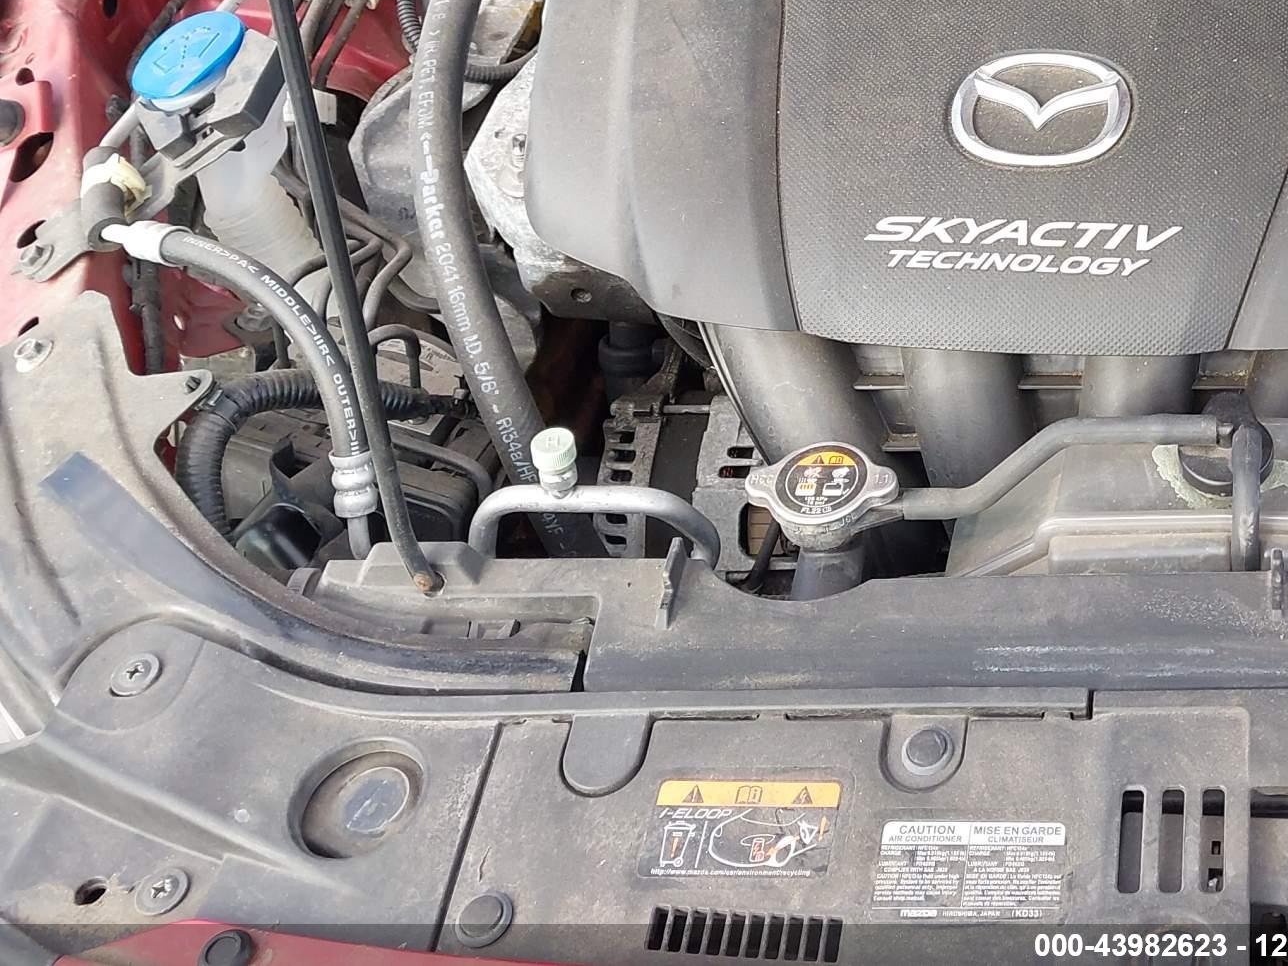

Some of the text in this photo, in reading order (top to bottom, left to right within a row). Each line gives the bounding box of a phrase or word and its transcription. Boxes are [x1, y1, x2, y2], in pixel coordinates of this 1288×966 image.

[863, 215, 1184, 251] SKYACTIV
[420, 168, 445, 239] Parker
[436, 242, 460, 284] 2041
[448, 284, 472, 333] 16mm
[886, 249, 1152, 277] TECHNOLOGY
[658, 807, 733, 820] I-ELOOP
[899, 825, 956, 835] CAUTION
[973, 826, 1062, 836] MISE EN GARDE
[888, 835, 962, 843] AIR CONDITIONER
[1011, 909, 1043, 919] (KD33)
